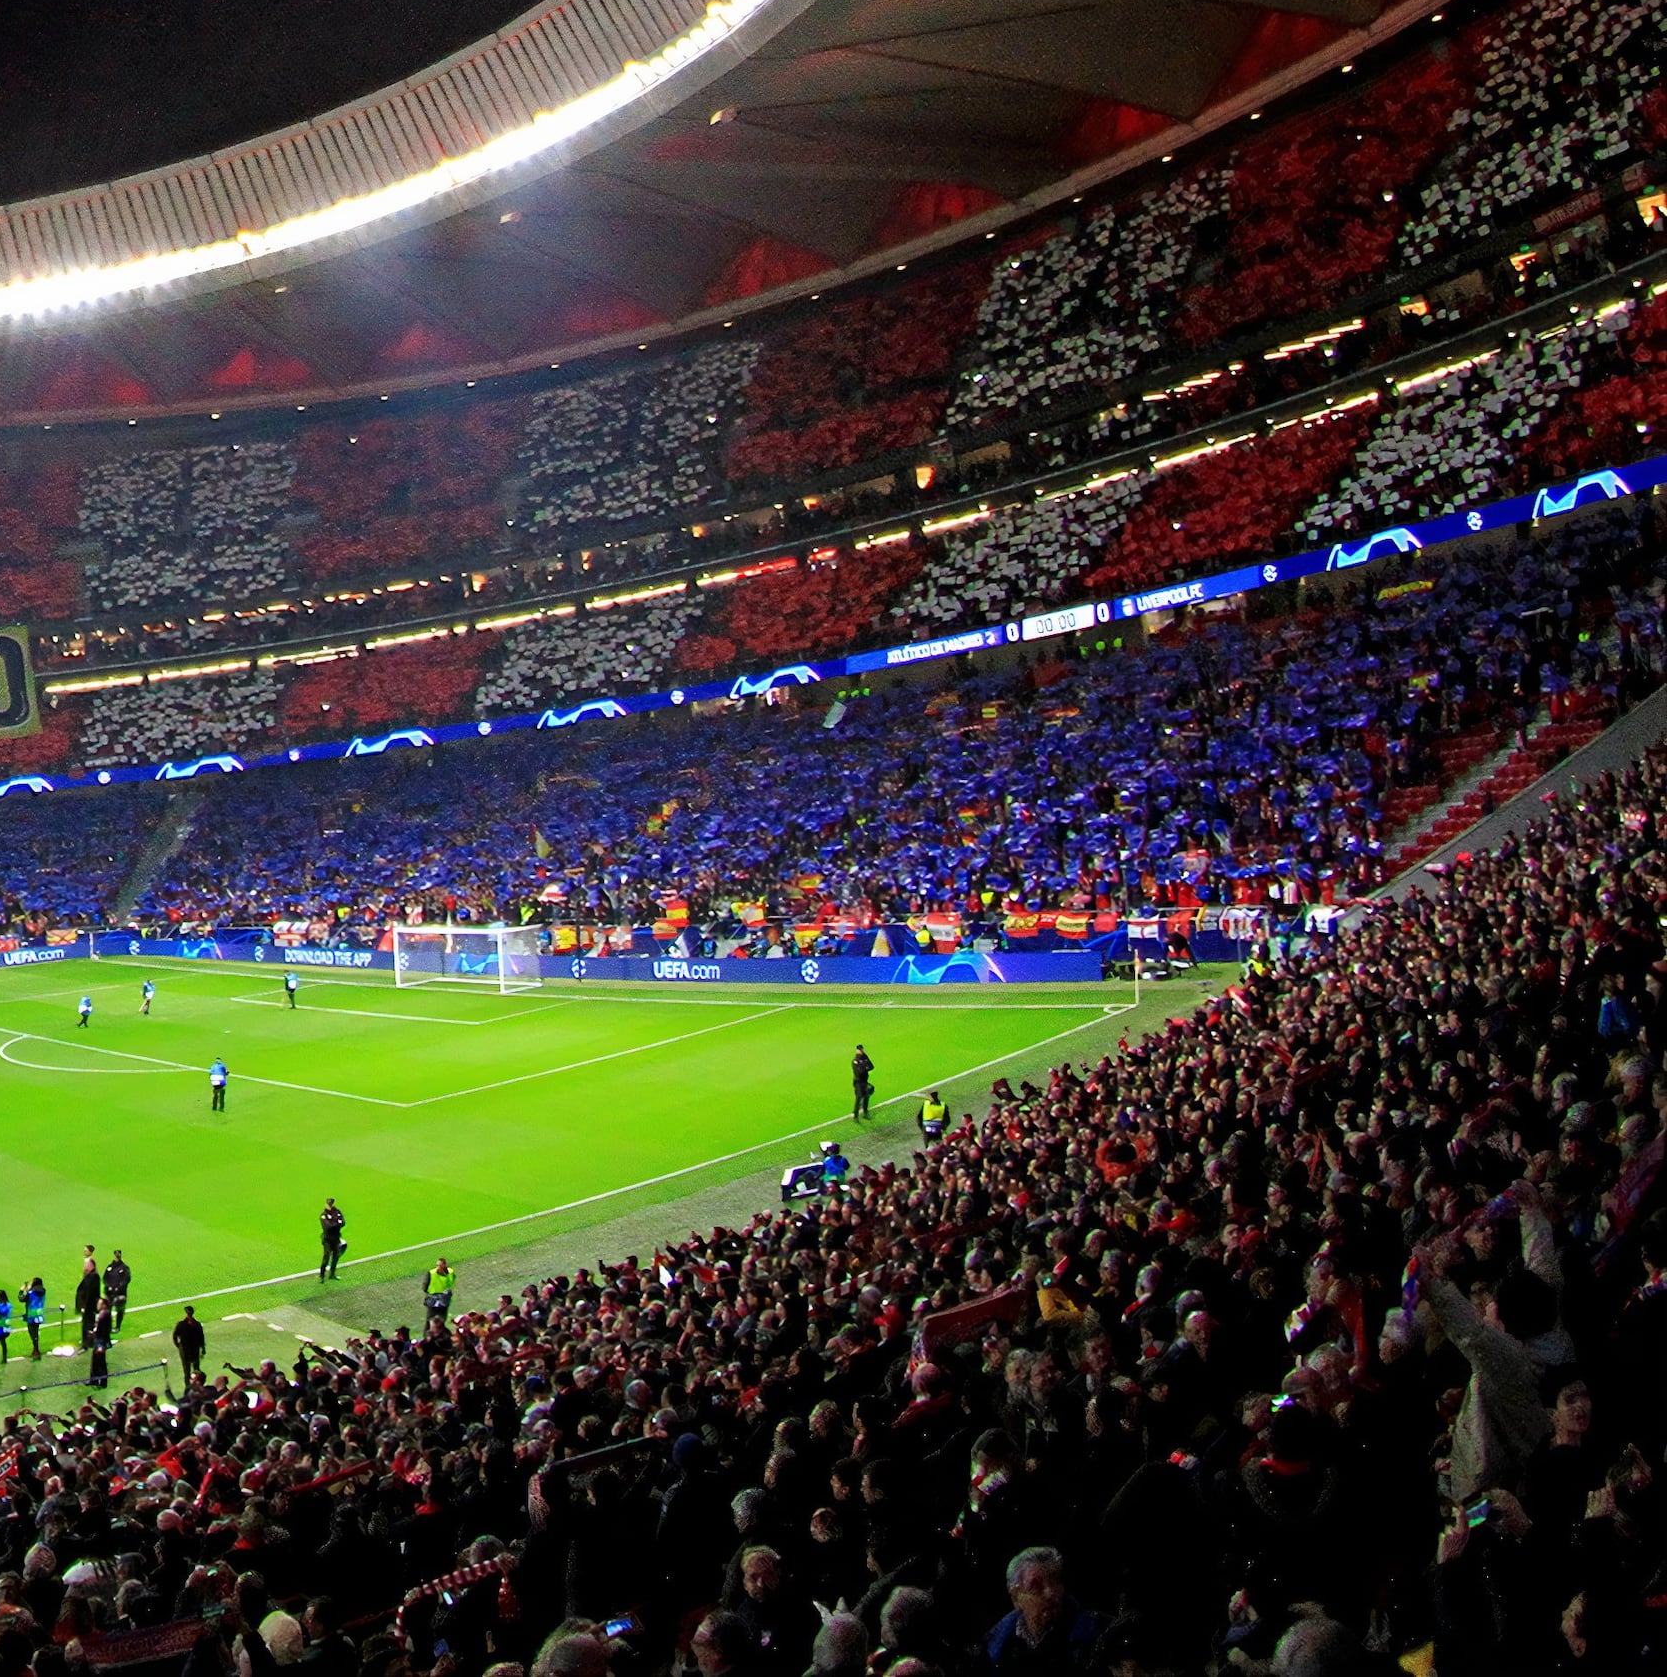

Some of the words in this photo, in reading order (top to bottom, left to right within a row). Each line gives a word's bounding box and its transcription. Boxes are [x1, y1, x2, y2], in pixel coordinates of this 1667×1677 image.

[1097, 602, 1110, 623] 0
[1006, 623, 1019, 642] 0
[4, 949, 65, 965] UEFA.com
[353, 952, 372, 967] APP
[653, 961, 721, 979] UEFA.com
